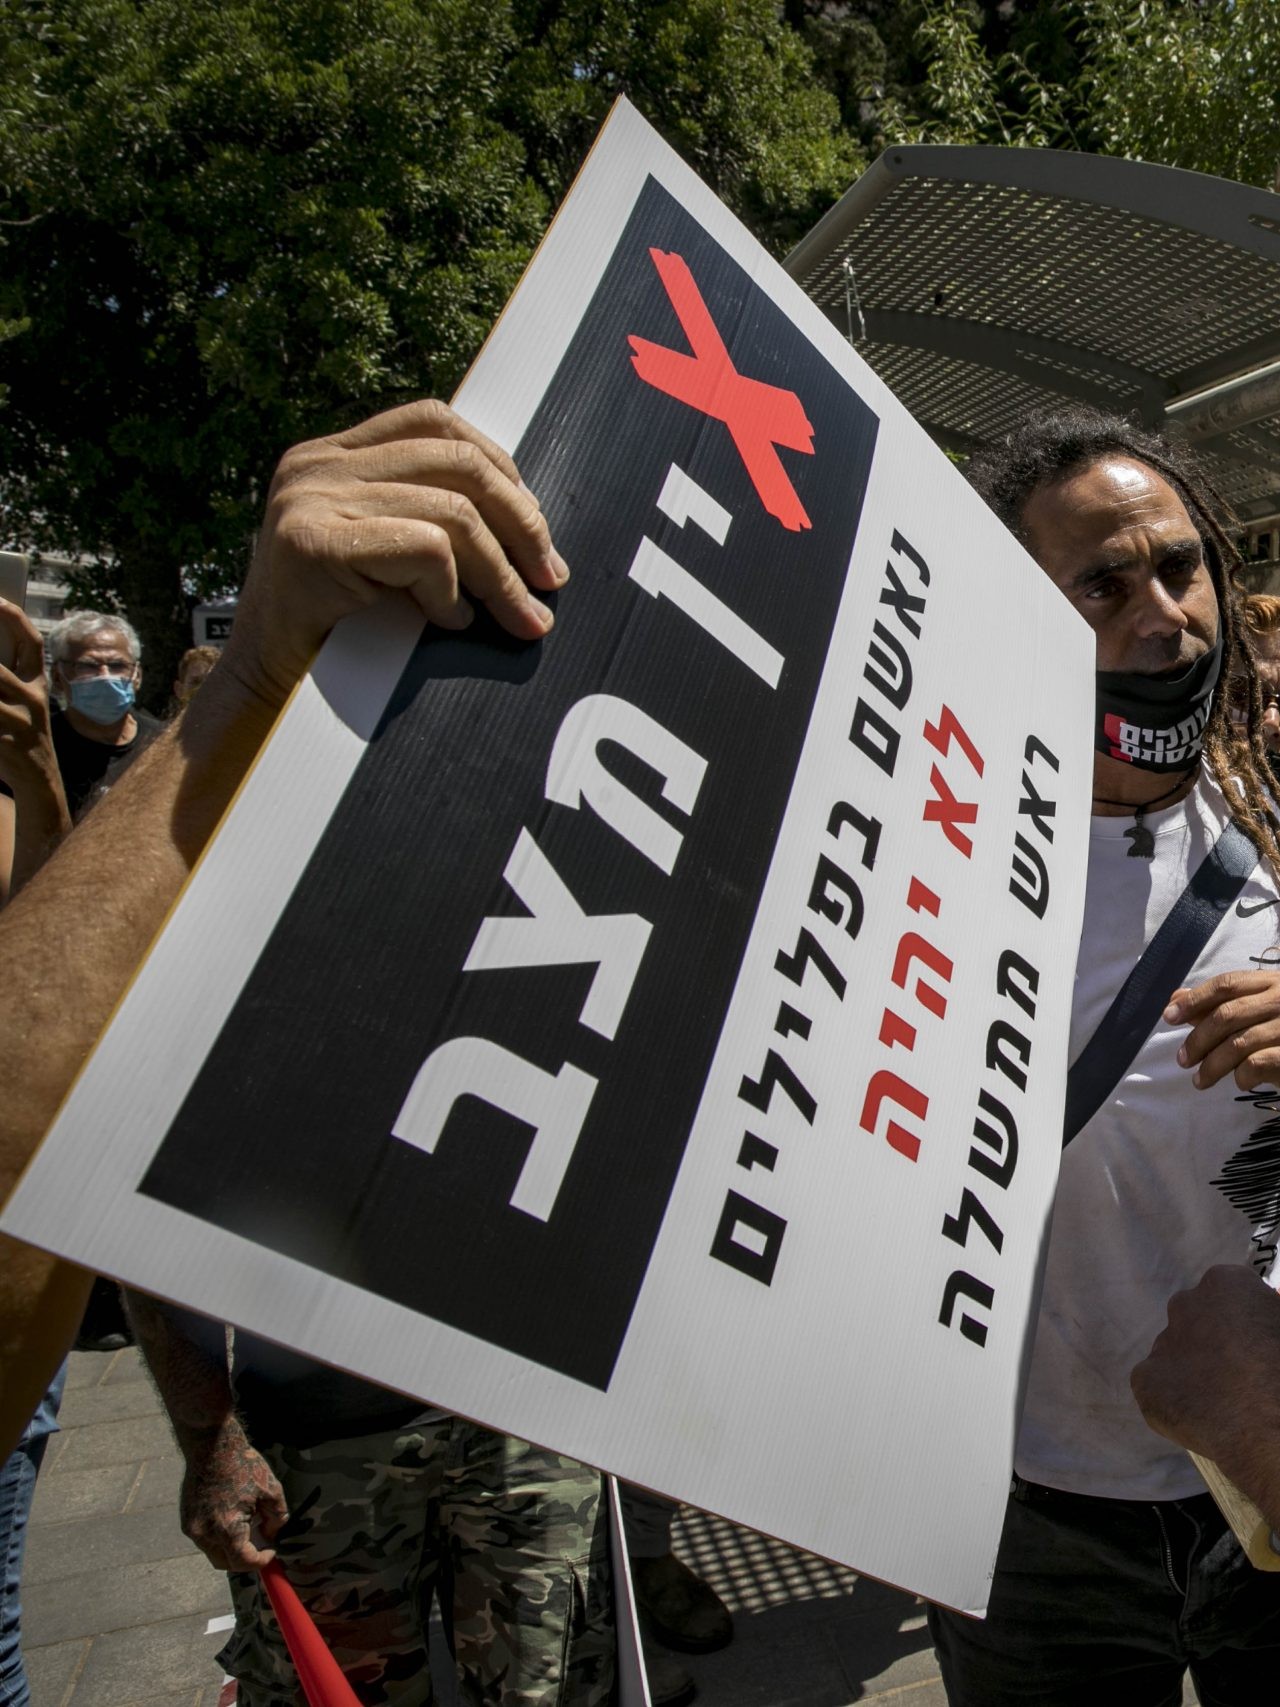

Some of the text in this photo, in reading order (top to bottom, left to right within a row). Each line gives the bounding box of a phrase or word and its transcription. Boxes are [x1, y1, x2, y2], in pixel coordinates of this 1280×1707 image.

[390, 247, 815, 1223] אין מצב
[709, 528, 930, 1287] נאשם בפלילים
[859, 703, 985, 1163] לא יהיה
[938, 734, 1060, 1348] ראש ממשלה
